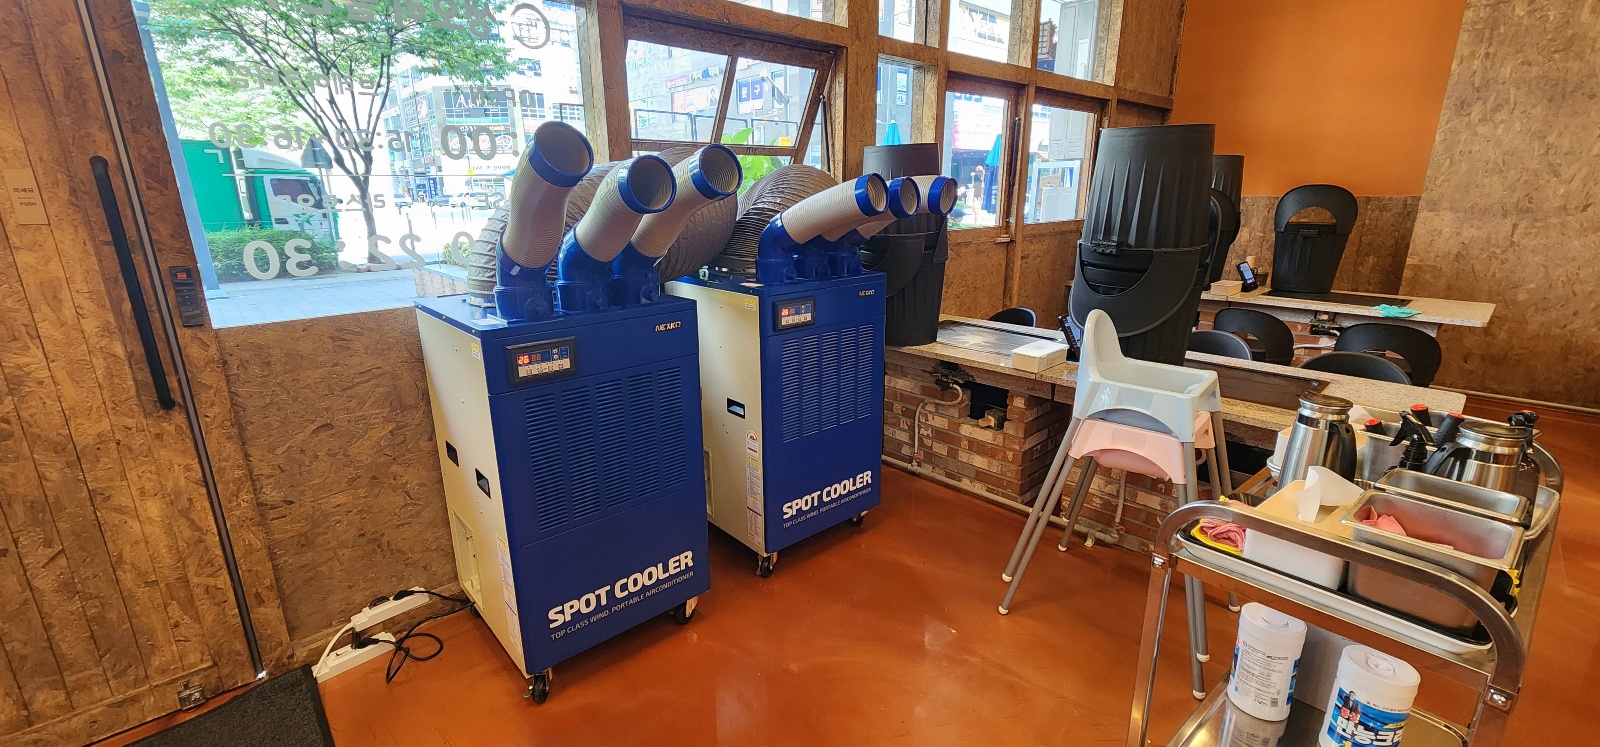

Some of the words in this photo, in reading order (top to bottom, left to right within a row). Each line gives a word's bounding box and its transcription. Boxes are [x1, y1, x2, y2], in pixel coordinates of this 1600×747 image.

[655, 321, 681, 332] NEXKO
[518, 355, 530, 364] 26
[782, 490, 821, 520] SPOT
[822, 470, 872, 503] COOLER
[783, 520, 793, 529] TOP
[792, 514, 807, 525] CLASS
[819, 500, 841, 514] PORTABLE
[547, 584, 611, 629] SPOT
[614, 550, 694, 599] COOLER
[550, 628, 566, 641] TOP
[566, 619, 589, 634] CLASS
[611, 593, 645, 614] PORTABLE
[645, 570, 694, 597] AIRCONDITIONER
